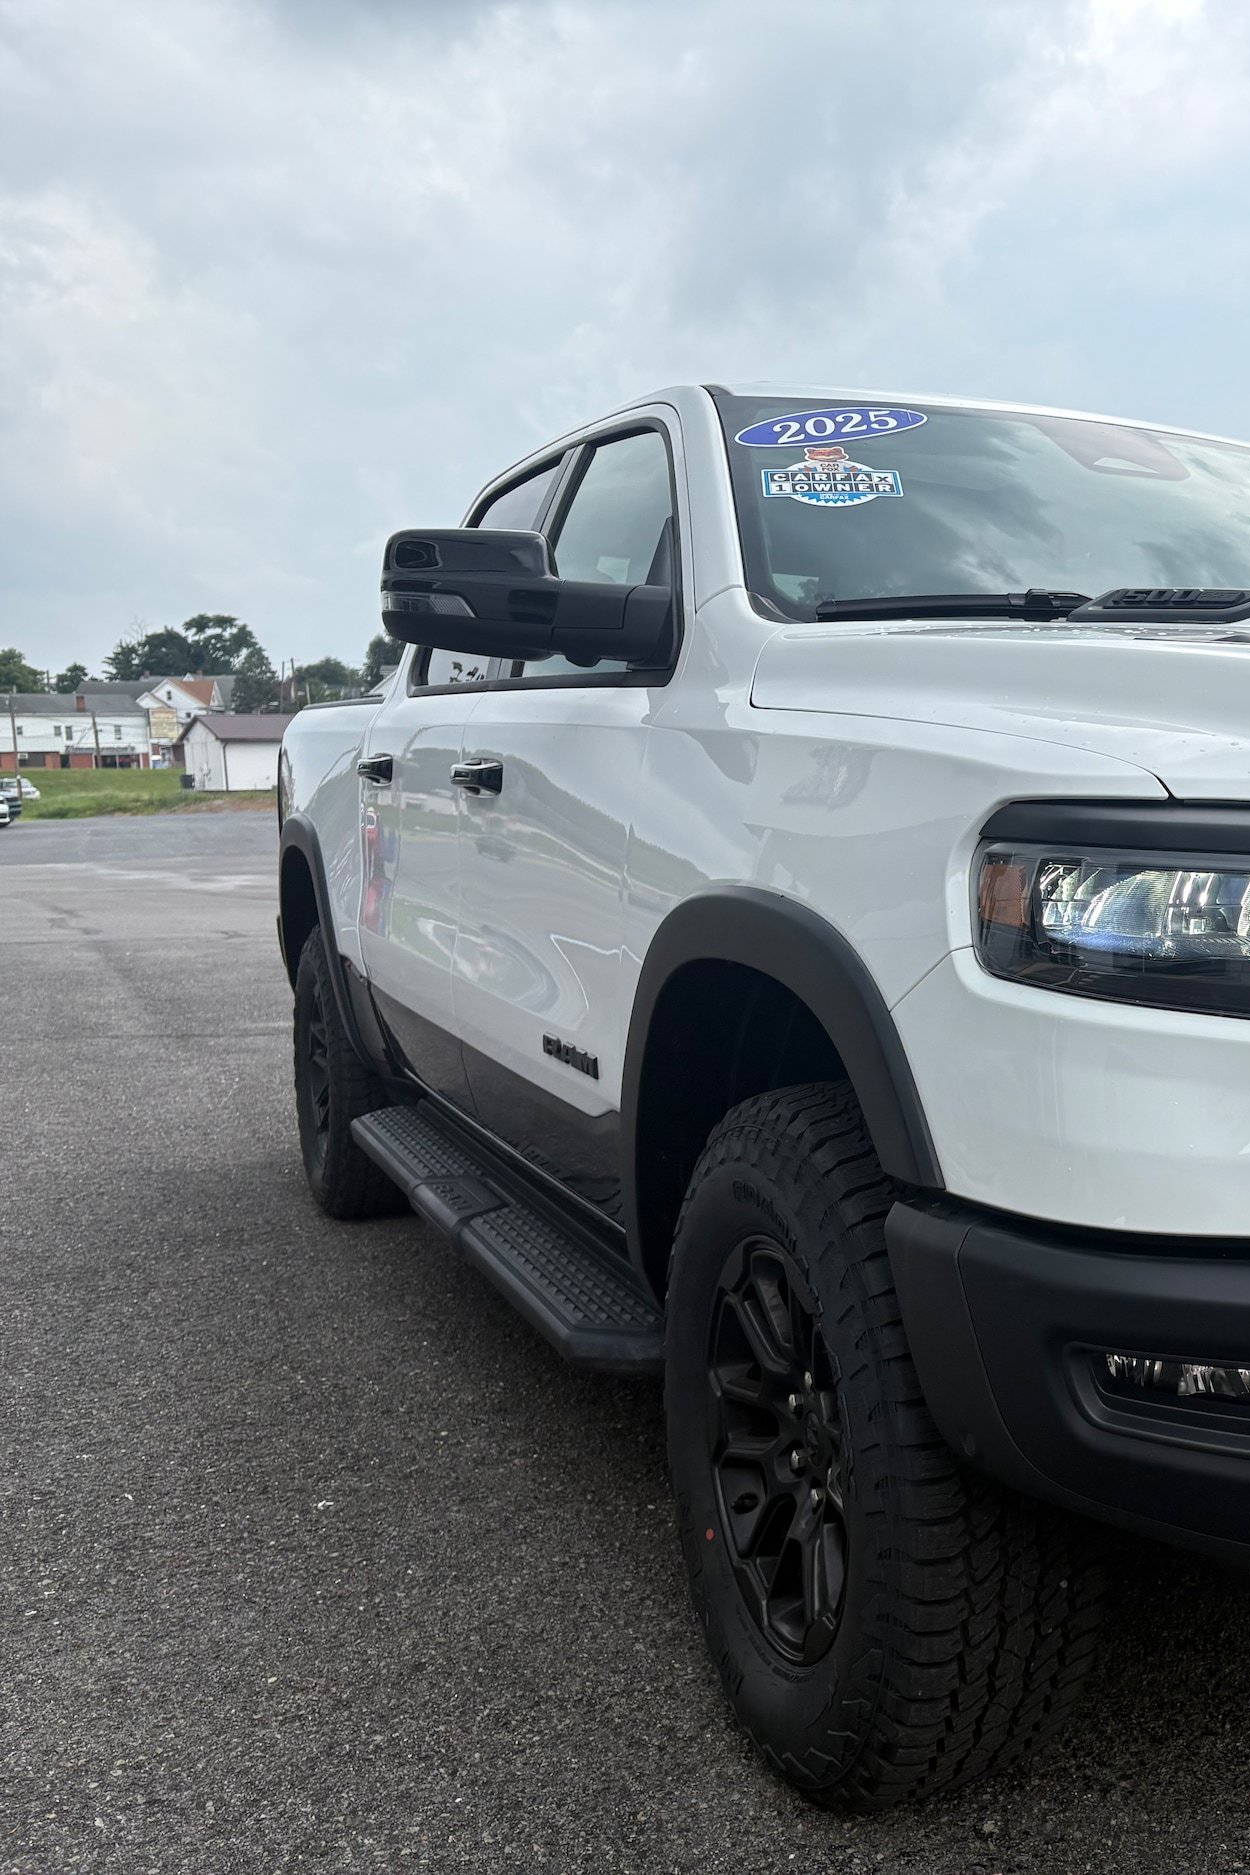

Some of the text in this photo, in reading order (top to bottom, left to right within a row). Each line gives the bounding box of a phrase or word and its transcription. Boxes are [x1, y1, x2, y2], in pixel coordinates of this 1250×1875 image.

[772, 410, 898, 444] 2025
[773, 473, 891, 483] CARFAX
[775, 483, 892, 492] 1 OWNER
[543, 1032, 599, 1080] RAM
